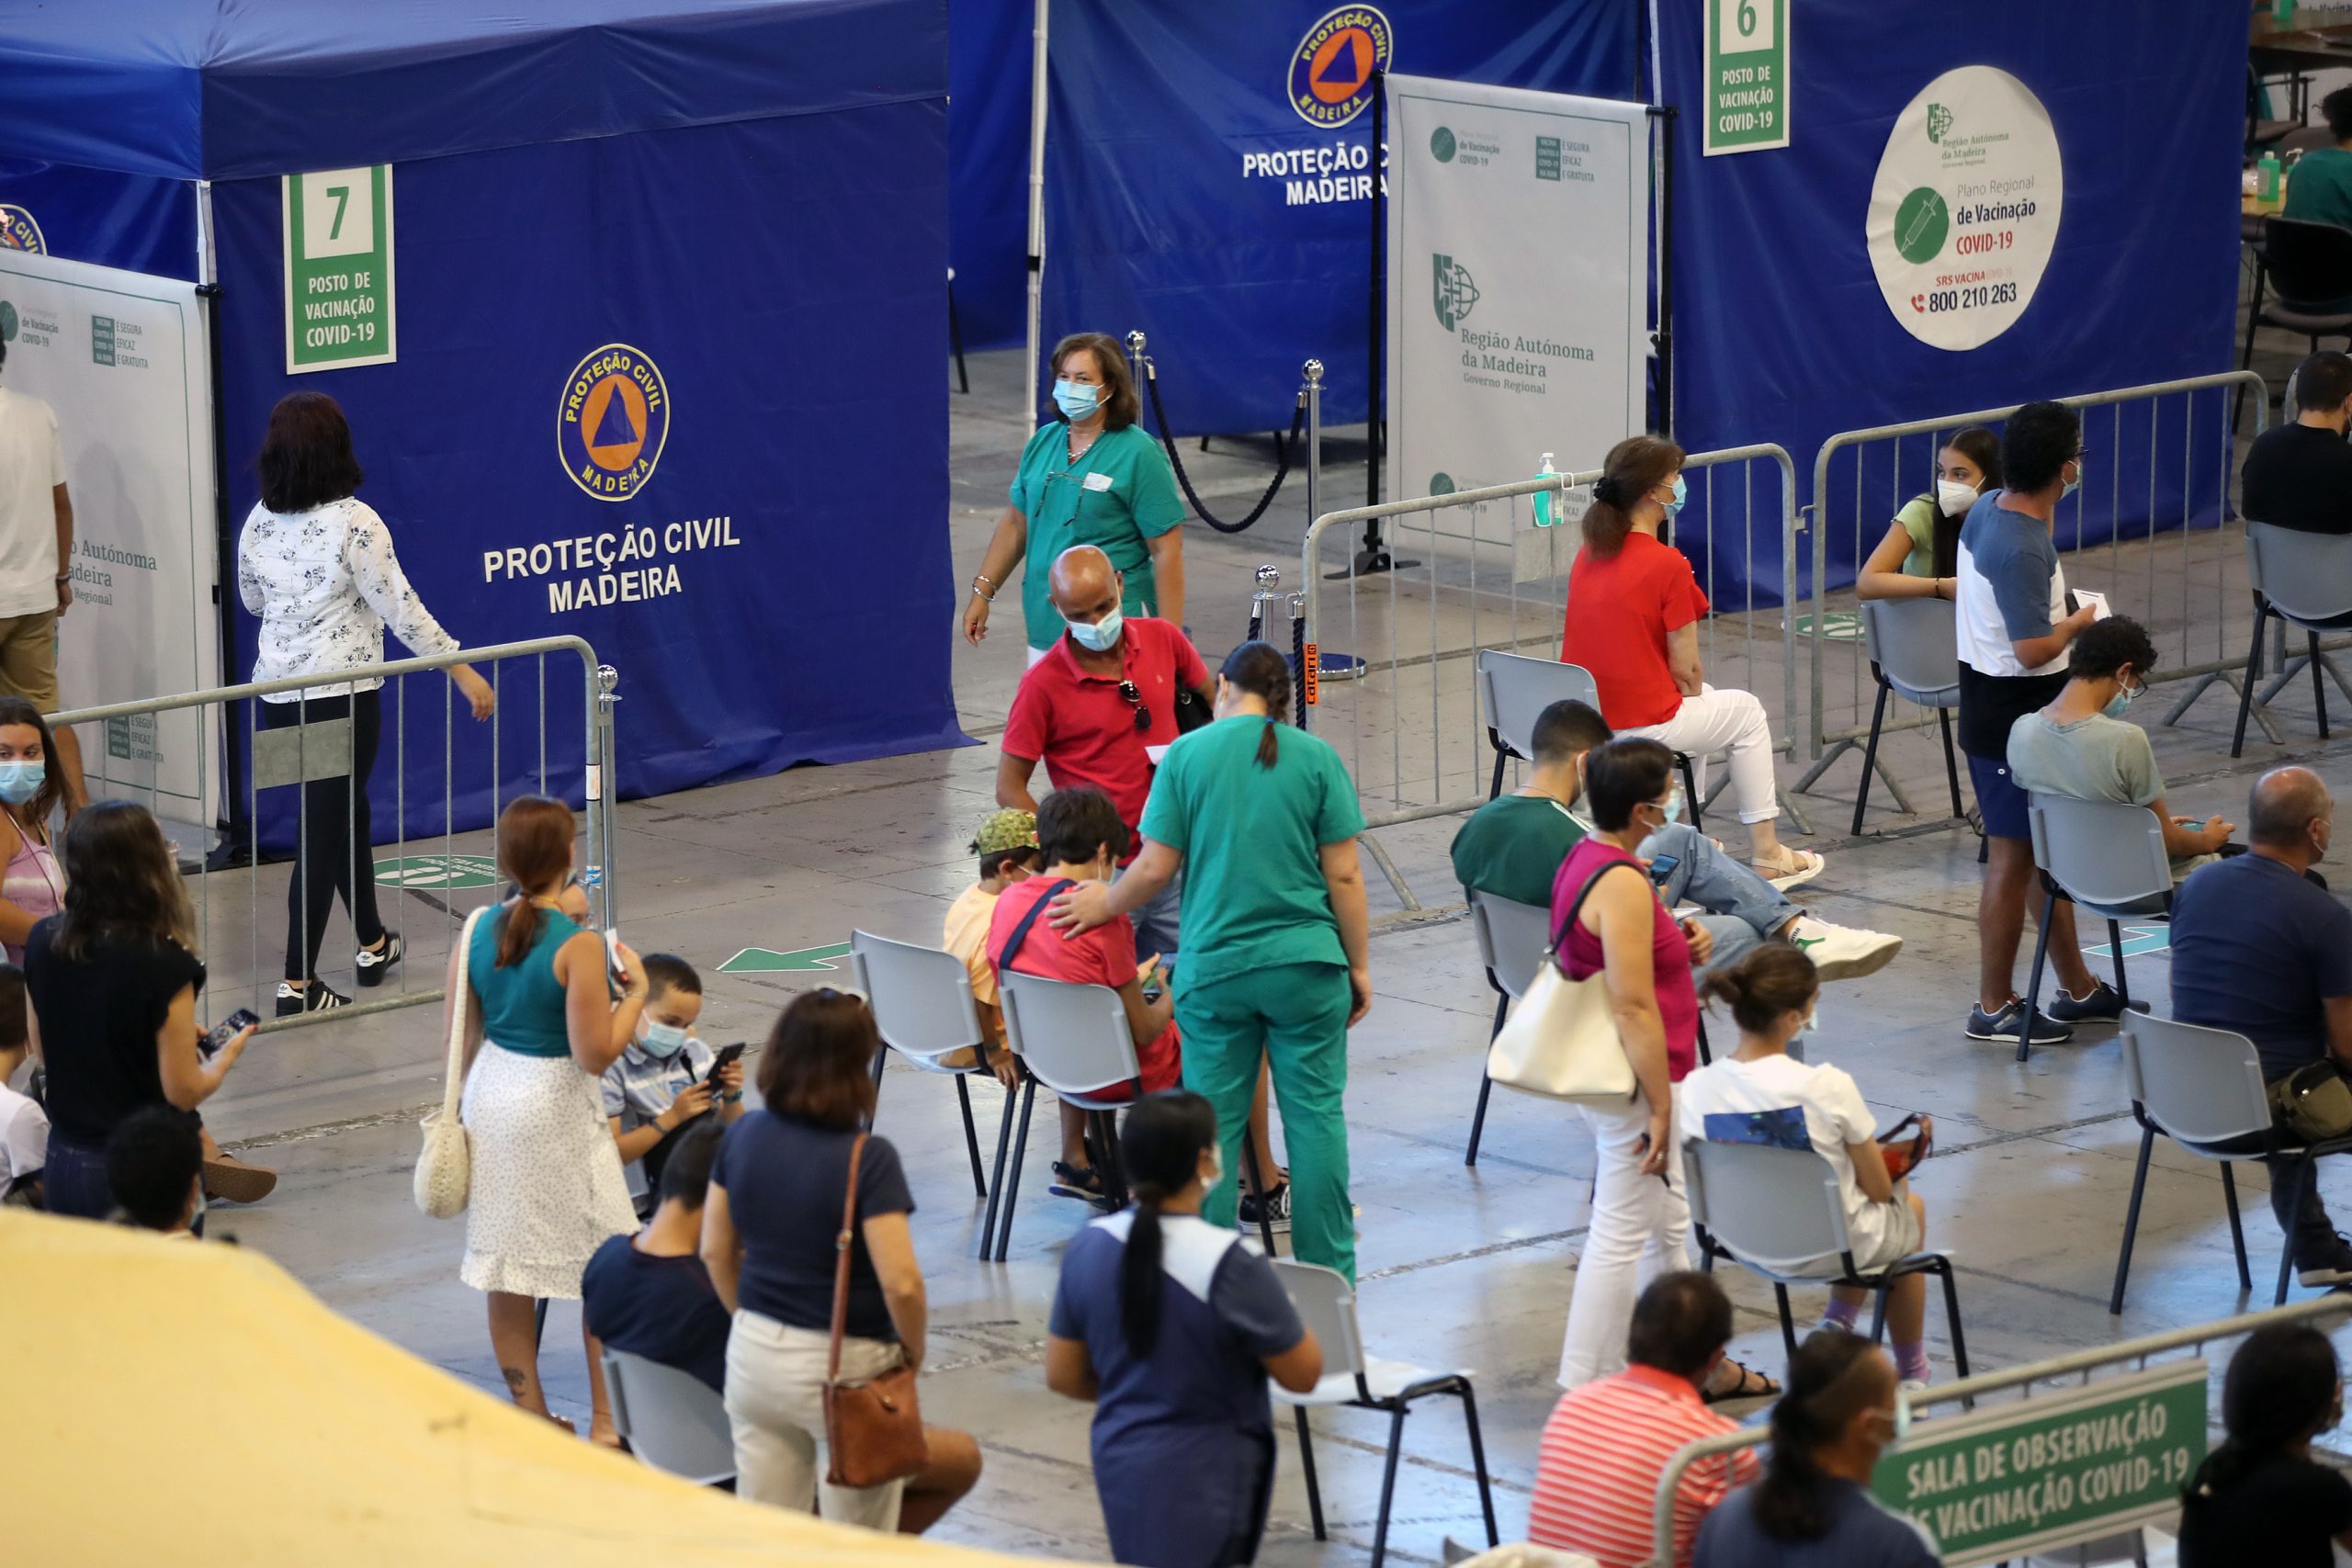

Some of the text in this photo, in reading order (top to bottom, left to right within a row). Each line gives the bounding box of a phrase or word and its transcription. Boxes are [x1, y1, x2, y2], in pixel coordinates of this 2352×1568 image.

[1736, 0, 1757, 37] 6
[1301, 11, 1387, 63] PROTEÇÃO CIVIL
[1722, 65, 1770, 85] POSTO DE
[1299, 94, 1362, 120] MADEIRA
[1719, 86, 1773, 108] VACINAÇÃO
[1719, 111, 1773, 133] COVID-19
[1242, 141, 1369, 178] PROTEÇÃO
[1957, 175, 2034, 199] Plano Regional
[326, 186, 350, 241] 7
[1957, 198, 2036, 225] de Vacinação
[16, 221, 39, 254] CIVI
[1956, 231, 2013, 255] COVID-19
[308, 271, 370, 295] POSTO DE
[1936, 275, 1953, 288] SRS
[1954, 271, 1985, 284] VACINA
[305, 294, 375, 321] VACINAÇÃO
[1929, 282, 2017, 312] 800 210 263
[306, 321, 375, 348] COVID-19
[1461, 327, 1595, 361] Região Autónoma
[1462, 350, 1547, 378] da Madeira
[565, 352, 662, 423] PROTEÇÃO CIVIL
[1463, 372, 1545, 394] Governo Regional
[582, 457, 649, 491] MADEIRA
[81, 539, 158, 570] Autónoma
[483, 516, 741, 583] PROTEÇÃO CIVIL
[69, 562, 113, 587] adeira
[548, 563, 682, 614] MADEIRA
[74, 587, 112, 605] Regional
[1906, 1400, 2167, 1500] SALA DE OBSERVAÇÃO
[1935, 1447, 2190, 1540] VACINAÇÃO COVID-19
